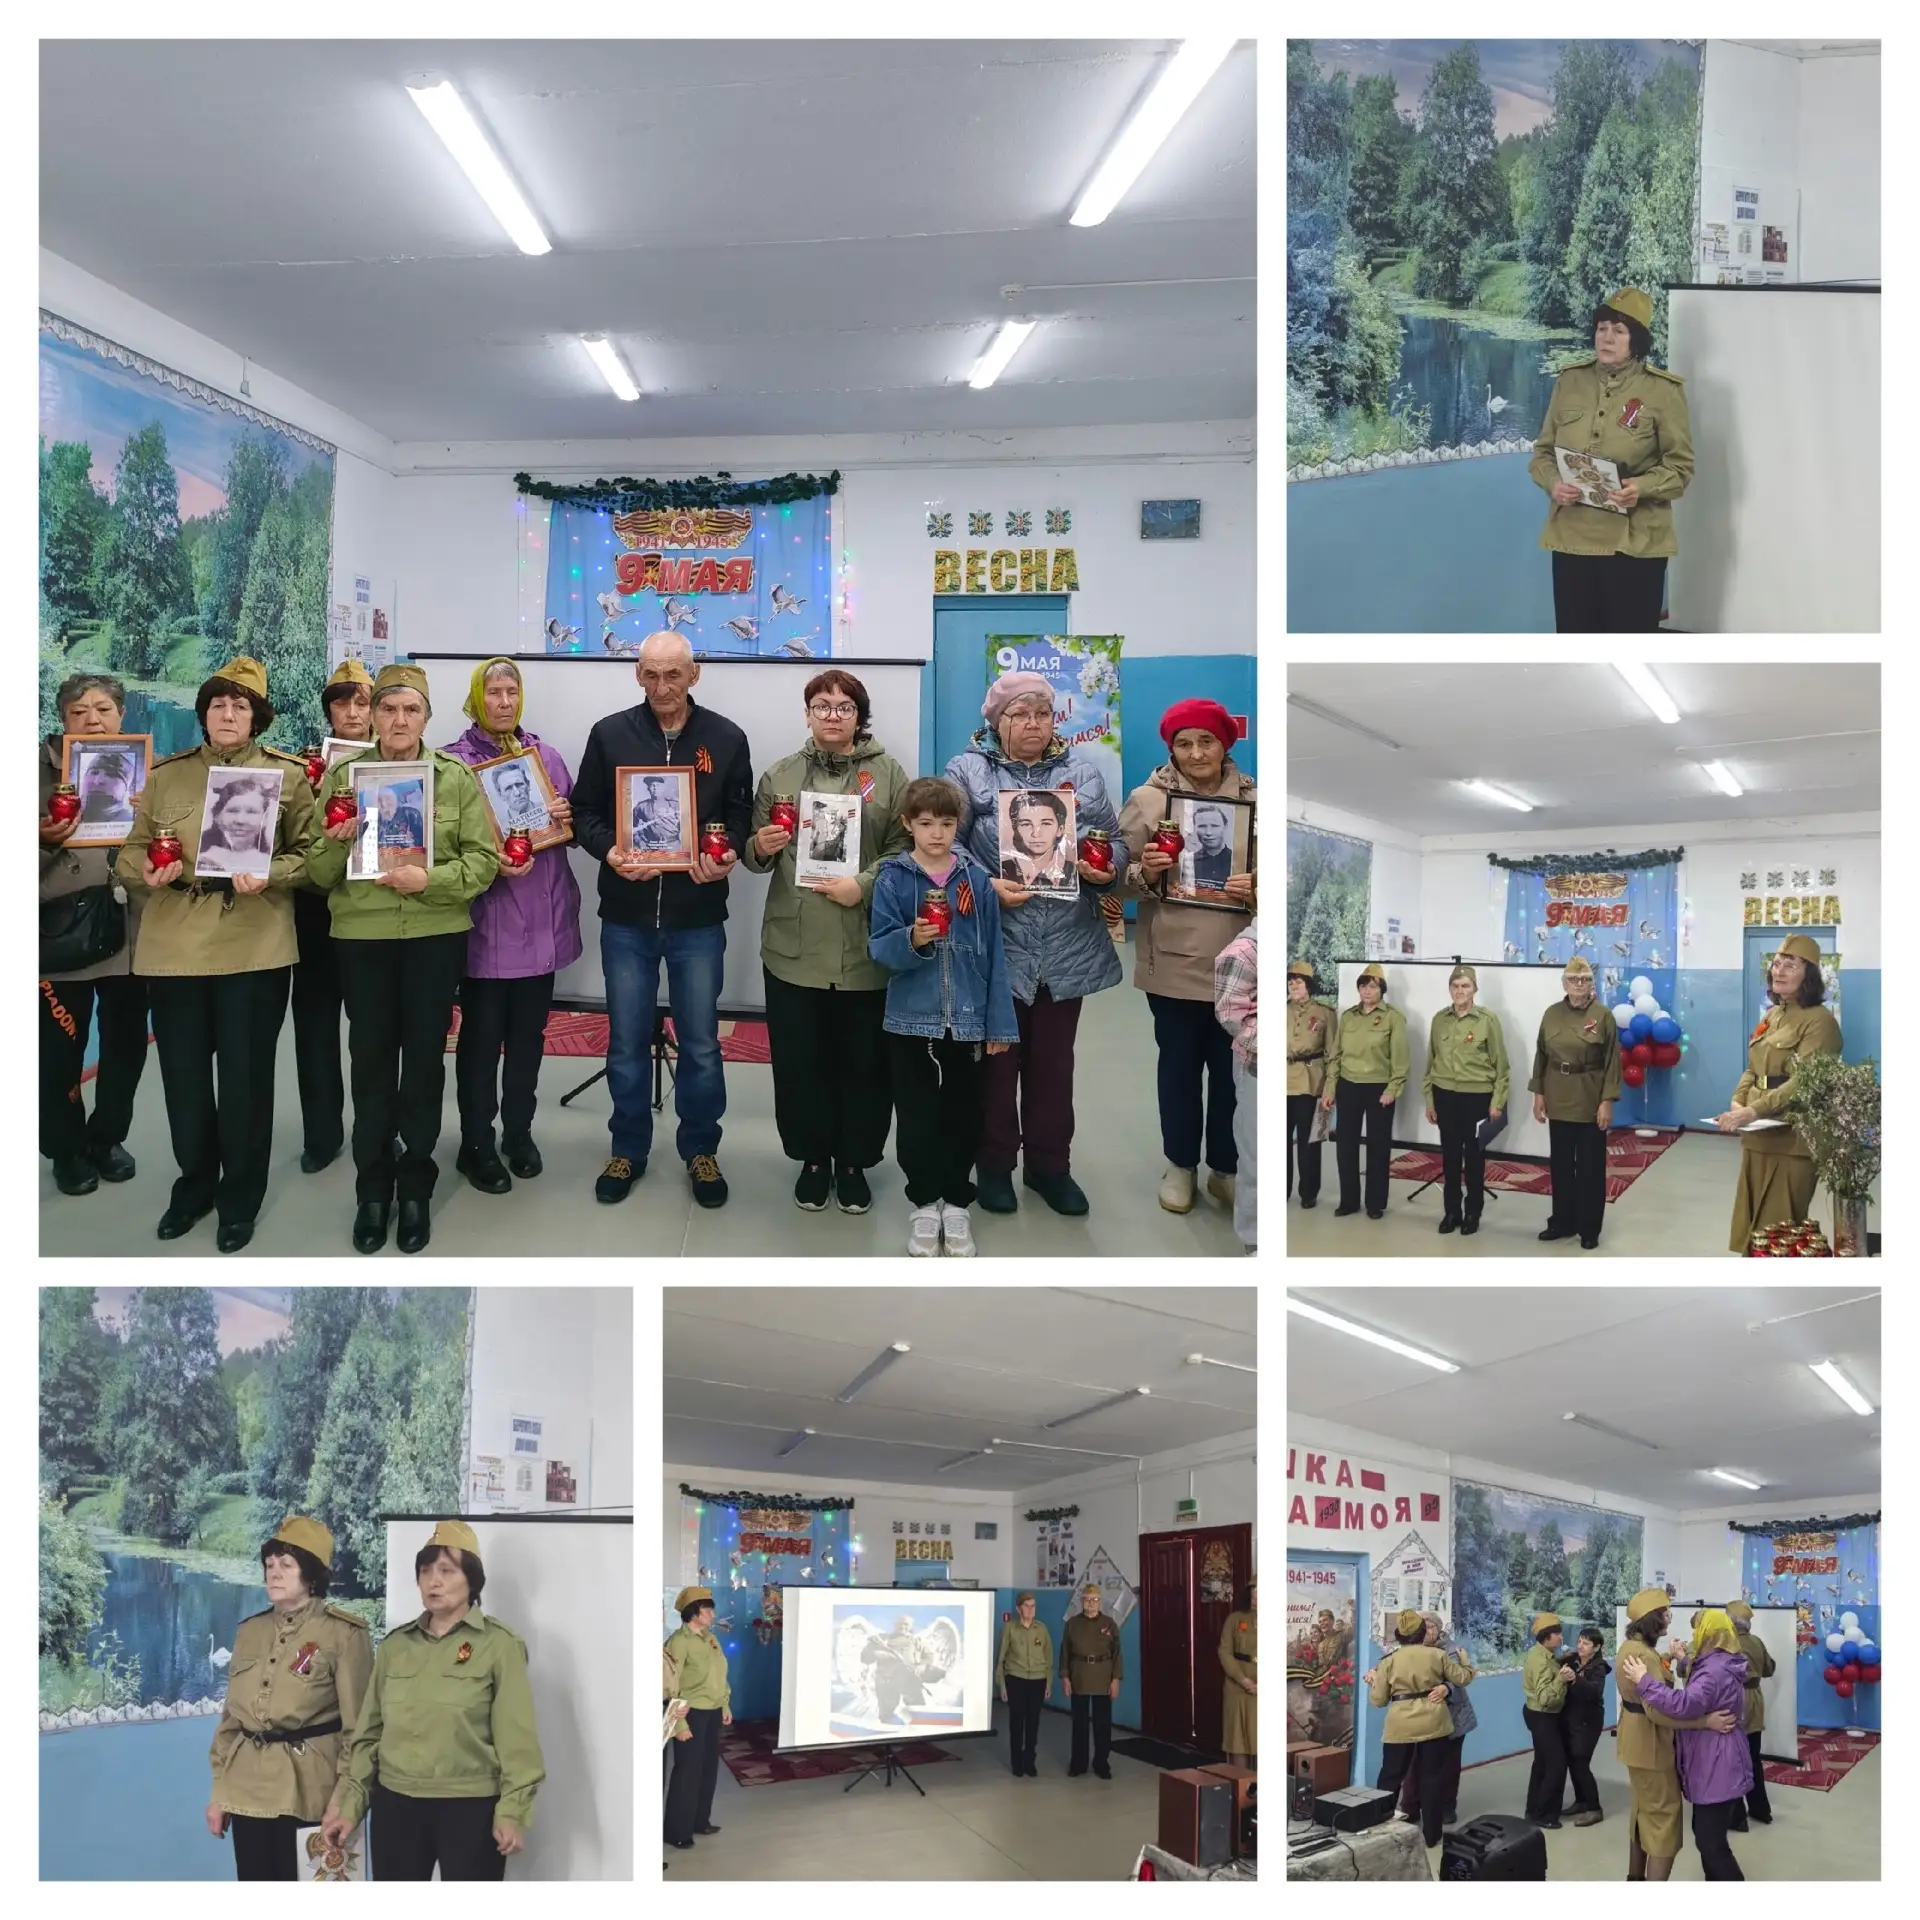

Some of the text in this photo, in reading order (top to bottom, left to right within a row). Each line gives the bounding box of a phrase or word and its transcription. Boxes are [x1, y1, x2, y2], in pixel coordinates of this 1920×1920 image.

[696, 536, 729, 548] 1945
[615, 553, 753, 595] 9 МАЯ
[934, 548, 1080, 593] ВЕСНА
[1021, 656, 1061, 670] МАЯ
[1546, 902, 1628, 927] 9 МАЯ
[1743, 895, 1842, 925] ВЕСНА
[1345, 1497, 1412, 1531] МОЯ
[895, 1539, 954, 1560] ВЕСНА
